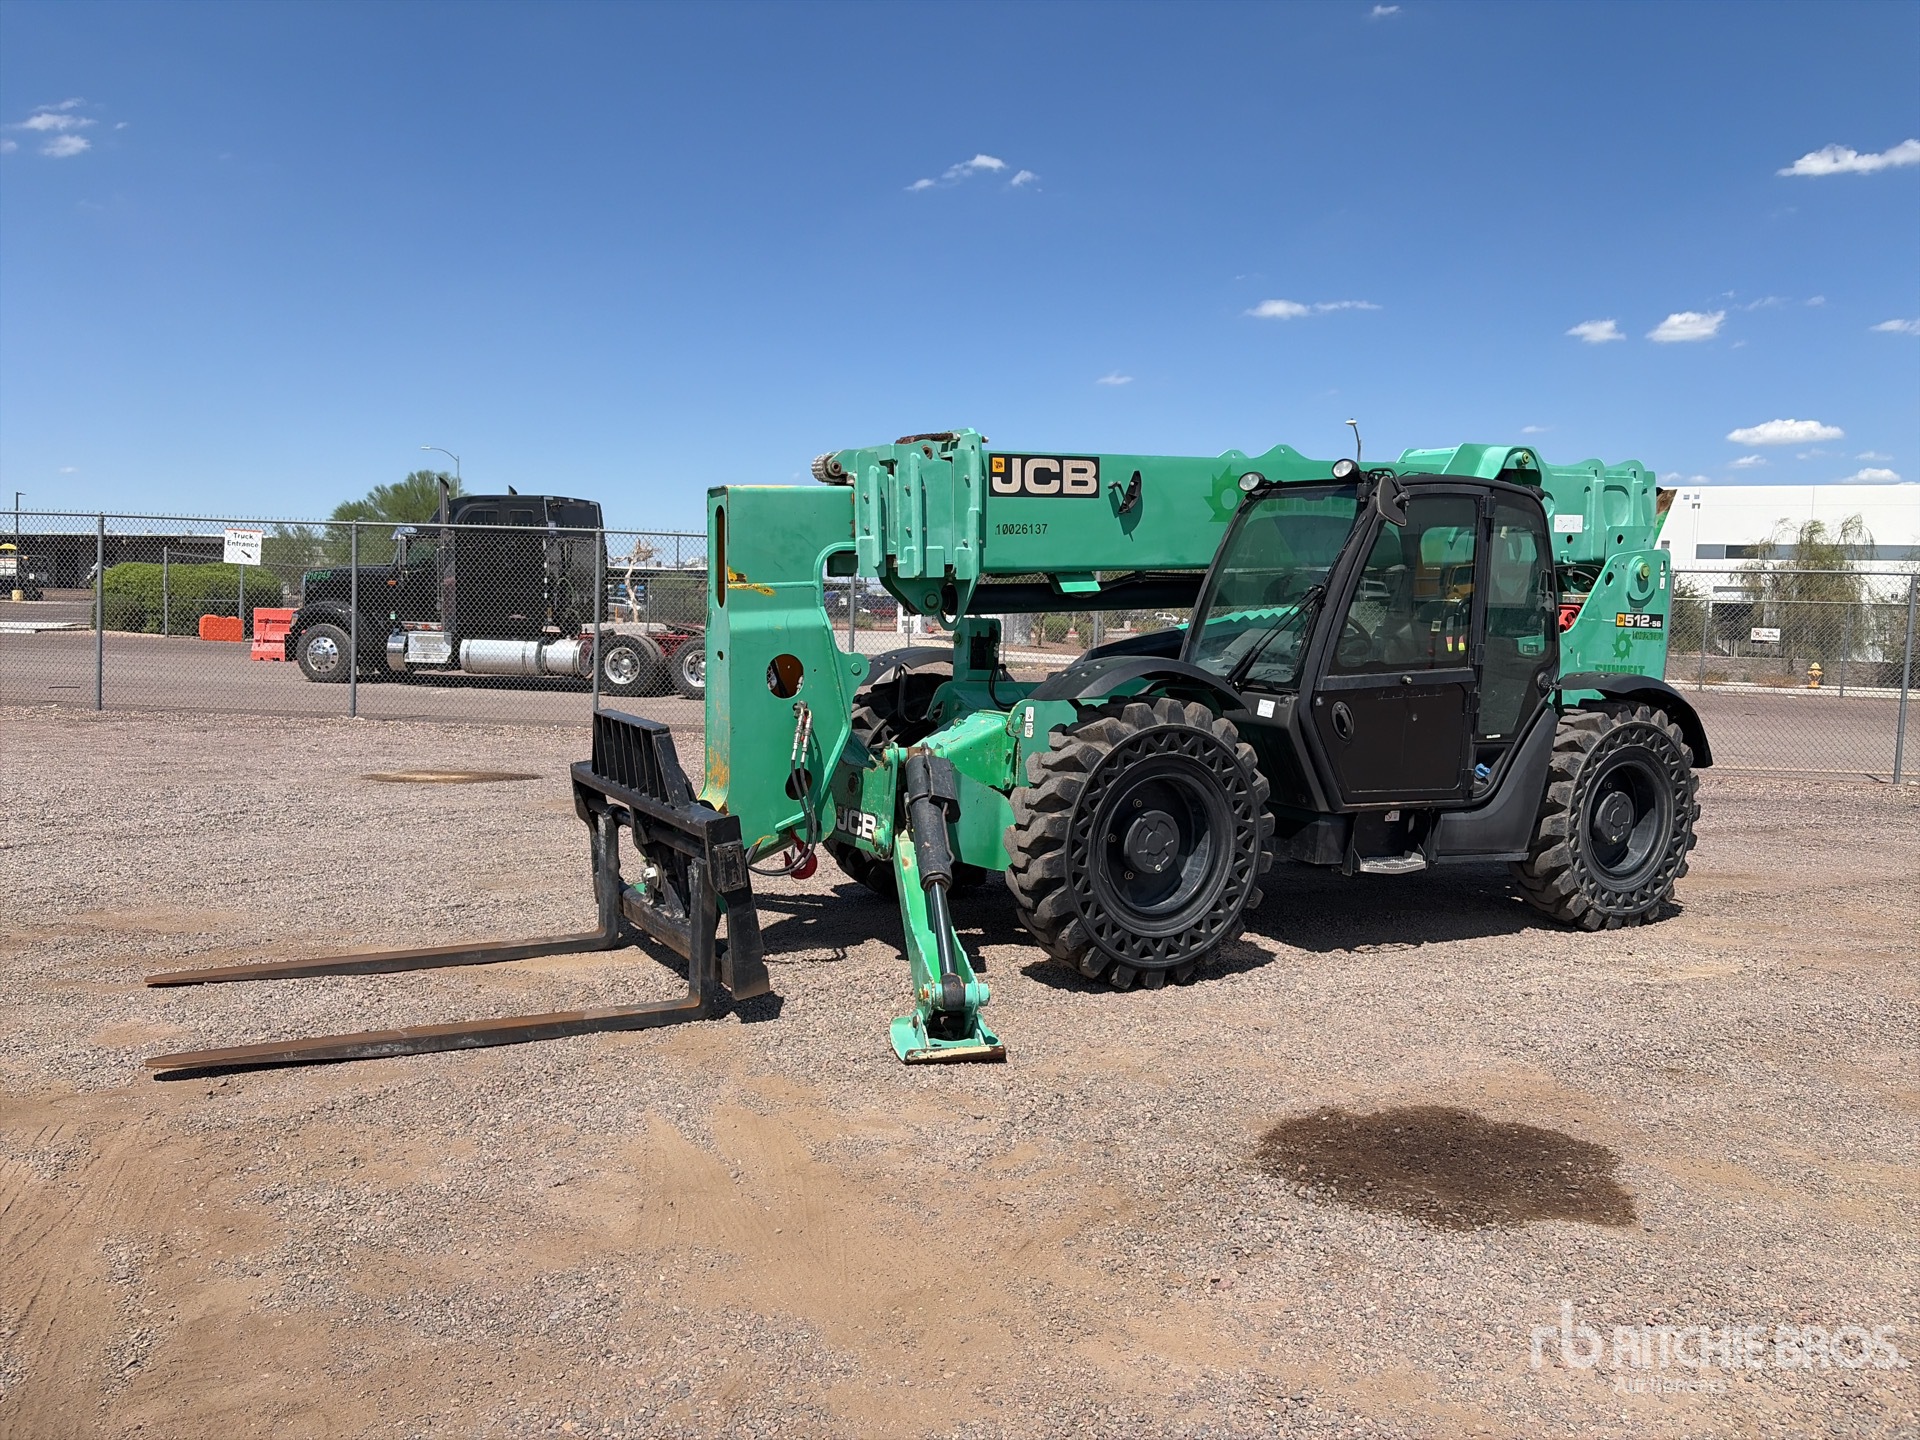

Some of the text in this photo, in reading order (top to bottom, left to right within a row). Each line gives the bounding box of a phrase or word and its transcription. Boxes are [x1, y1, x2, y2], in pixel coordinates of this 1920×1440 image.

[992, 457, 1098, 495] JCB
[995, 523, 1048, 535] 10026137
[233, 532, 254, 540] Truck
[226, 539, 259, 548] Entrance
[836, 807, 877, 840] JCB
